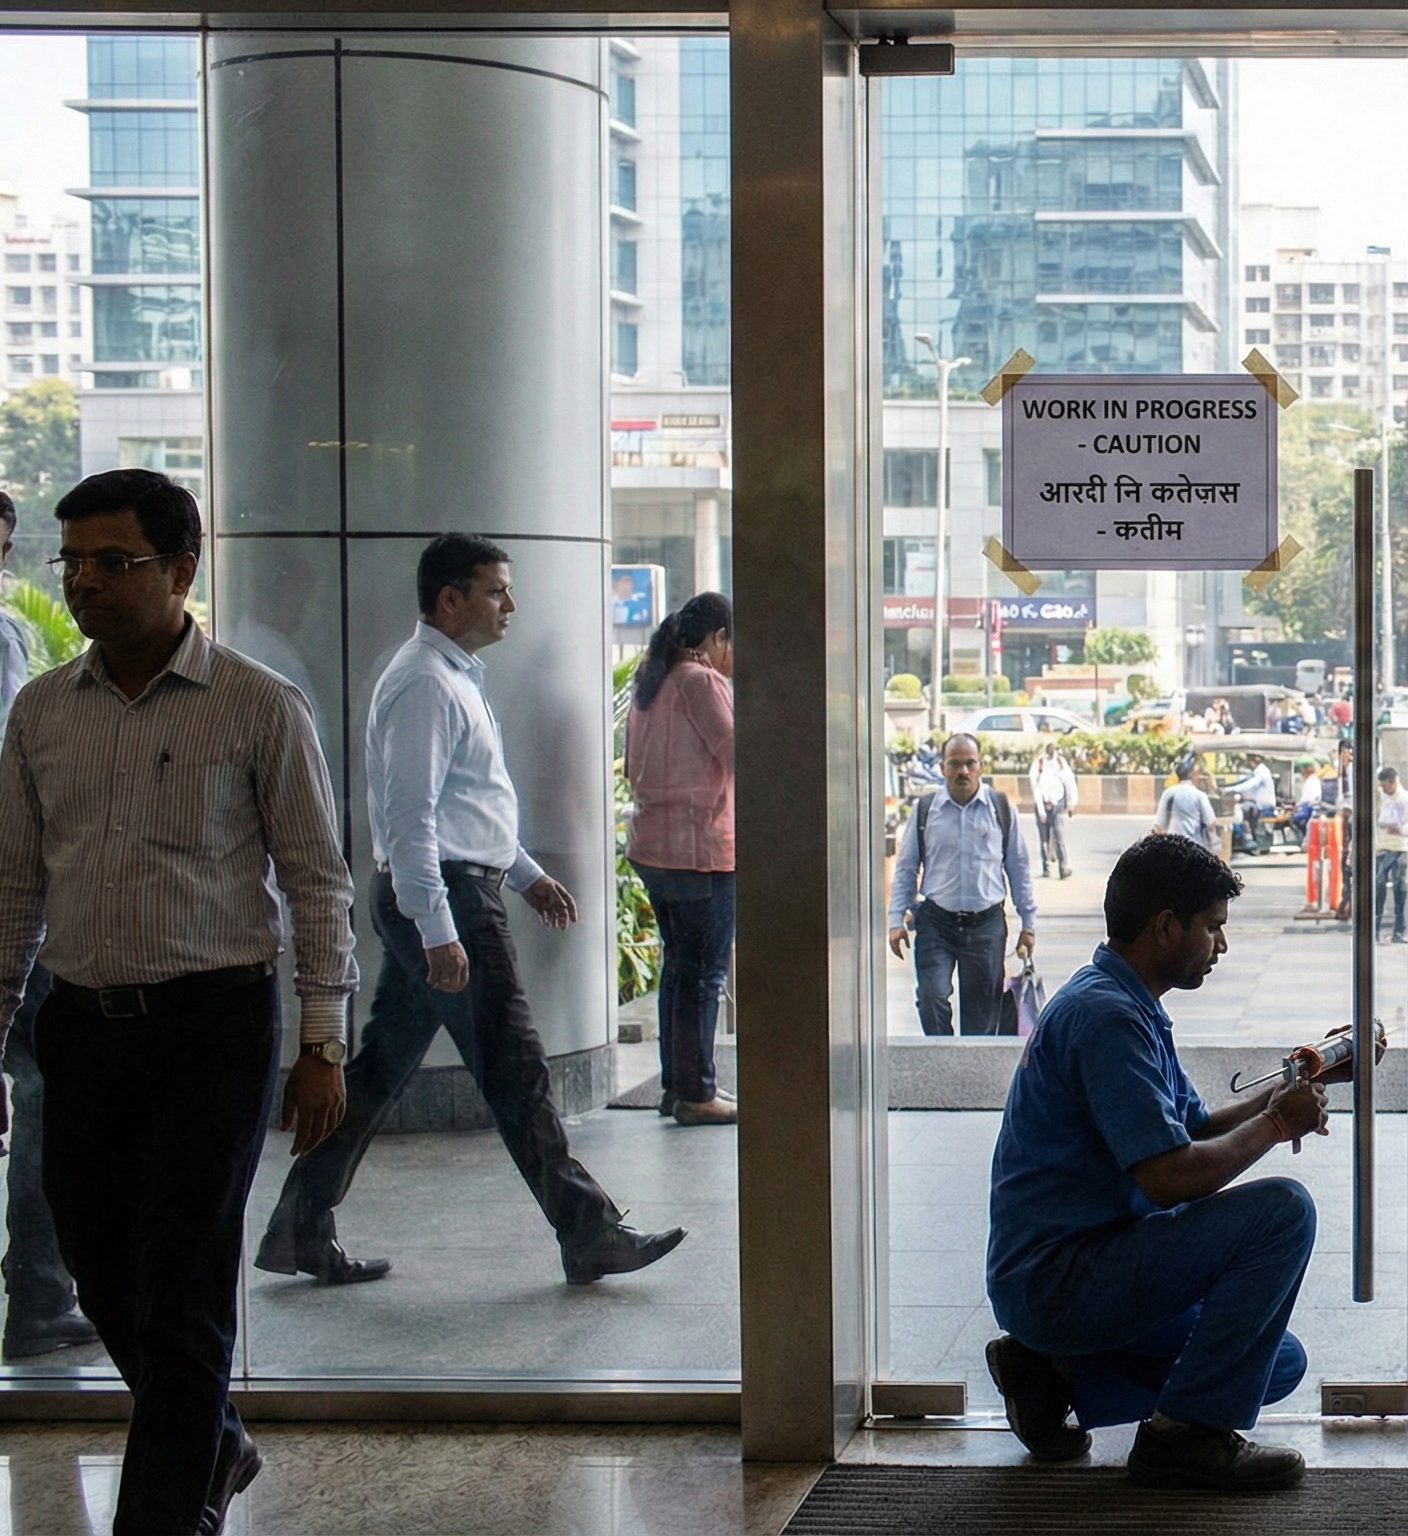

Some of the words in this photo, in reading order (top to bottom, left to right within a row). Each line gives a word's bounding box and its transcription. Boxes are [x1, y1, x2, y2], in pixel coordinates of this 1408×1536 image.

[1022, 399, 1096, 420] WORK
[1103, 399, 1128, 420] IN
[1135, 399, 1258, 420] PROGRESS
[1093, 434, 1201, 454] CAUTION
[1039, 473, 1108, 504] आरदी
[1113, 474, 1143, 504] नि
[1112, 512, 1185, 541] कतीम
